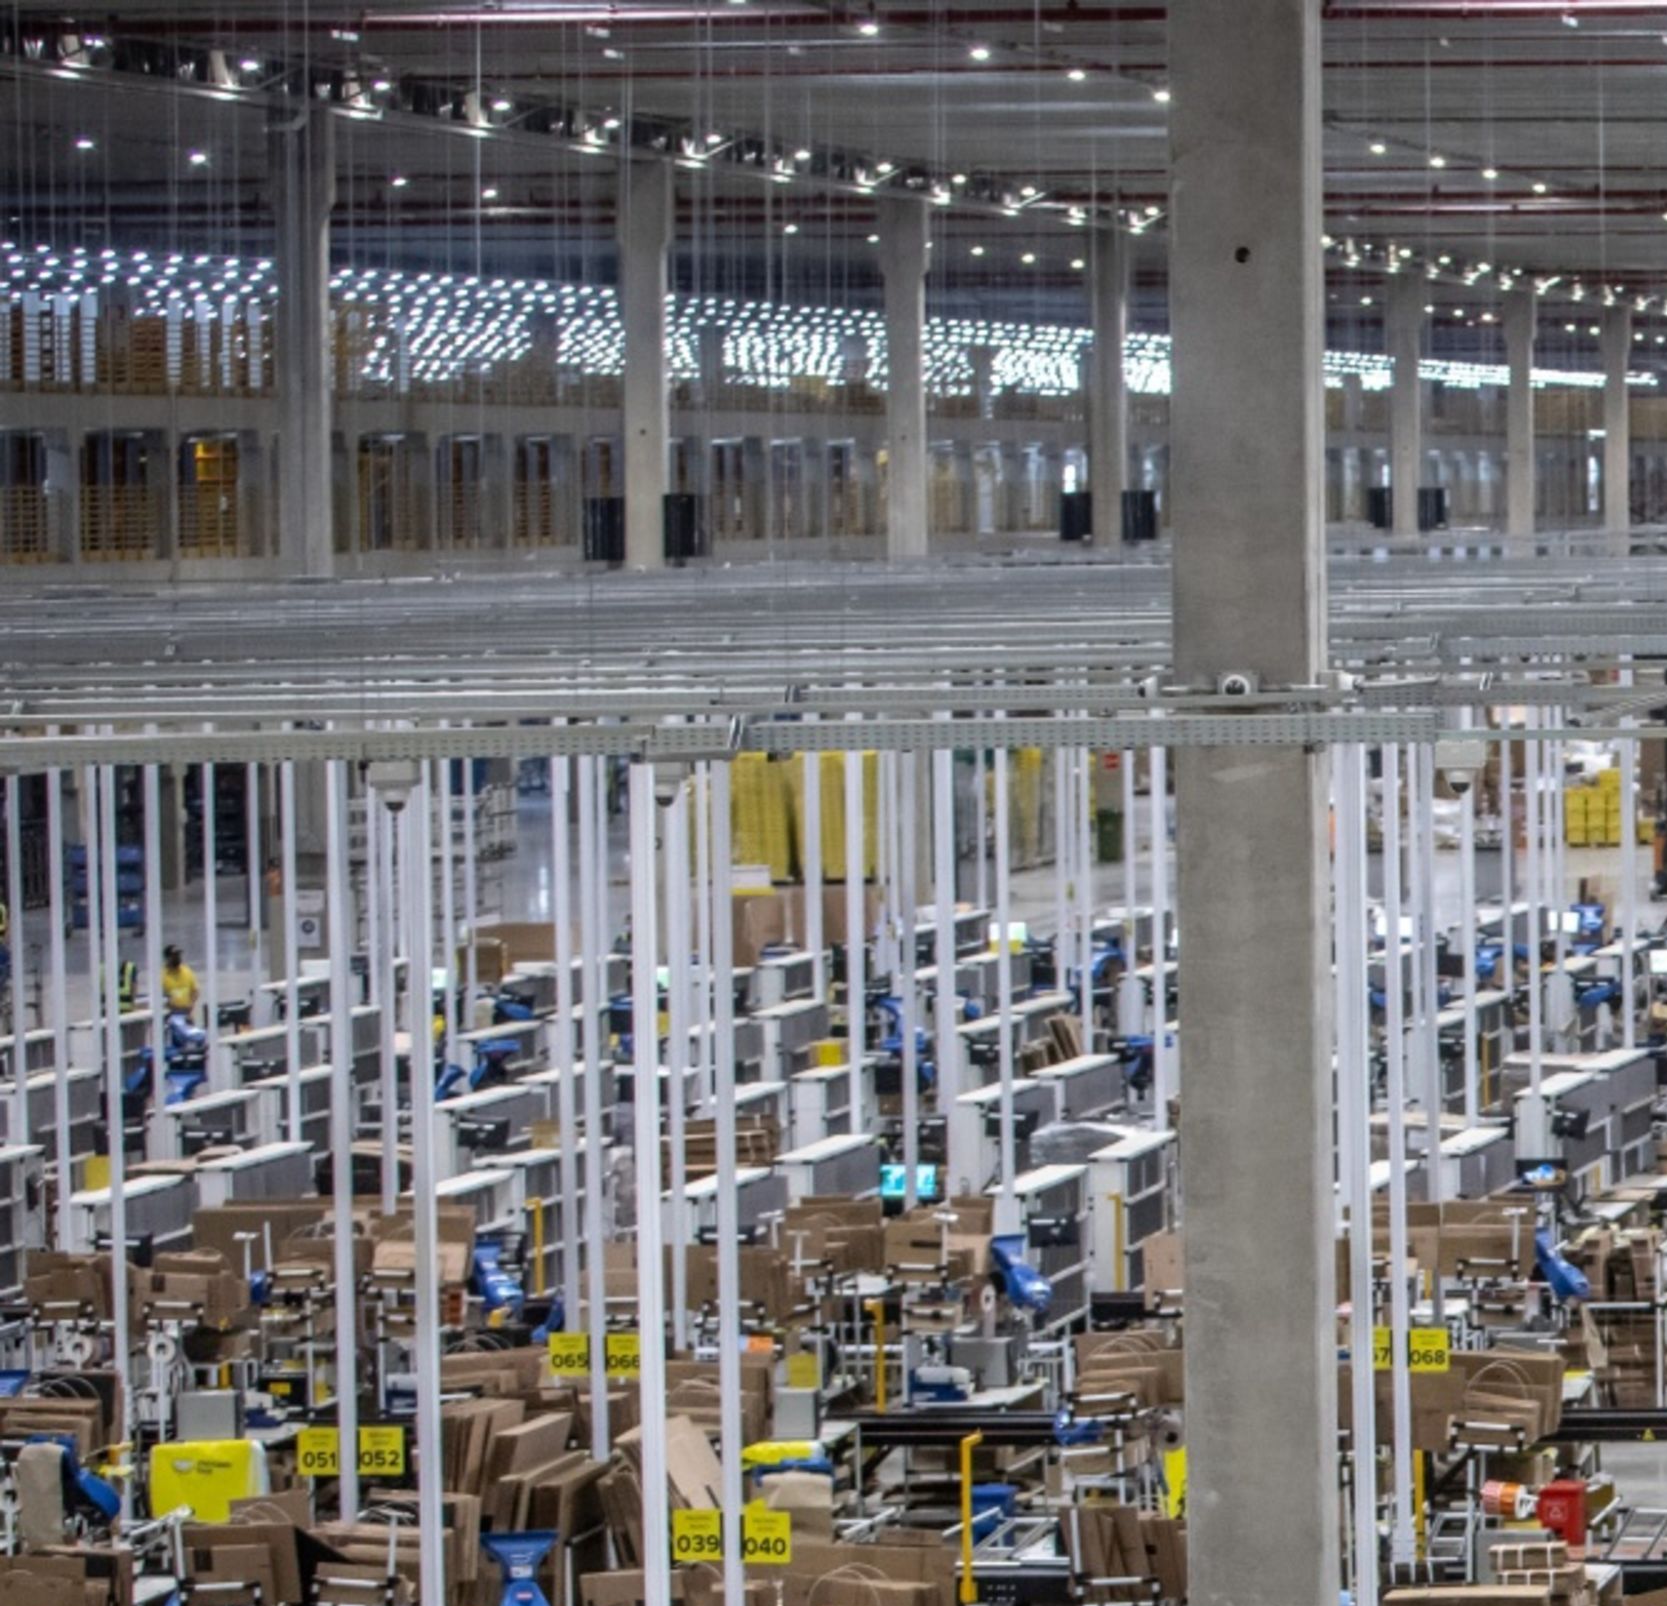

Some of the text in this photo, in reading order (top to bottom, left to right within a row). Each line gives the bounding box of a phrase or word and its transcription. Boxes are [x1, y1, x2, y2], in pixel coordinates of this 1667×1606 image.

[552, 1354, 587, 1368] 065
[1411, 1350, 1446, 1365] 068
[302, 1451, 336, 1468] 051
[361, 1450, 400, 1467] 052
[677, 1534, 719, 1553] 039
[744, 1537, 786, 1555] 040
